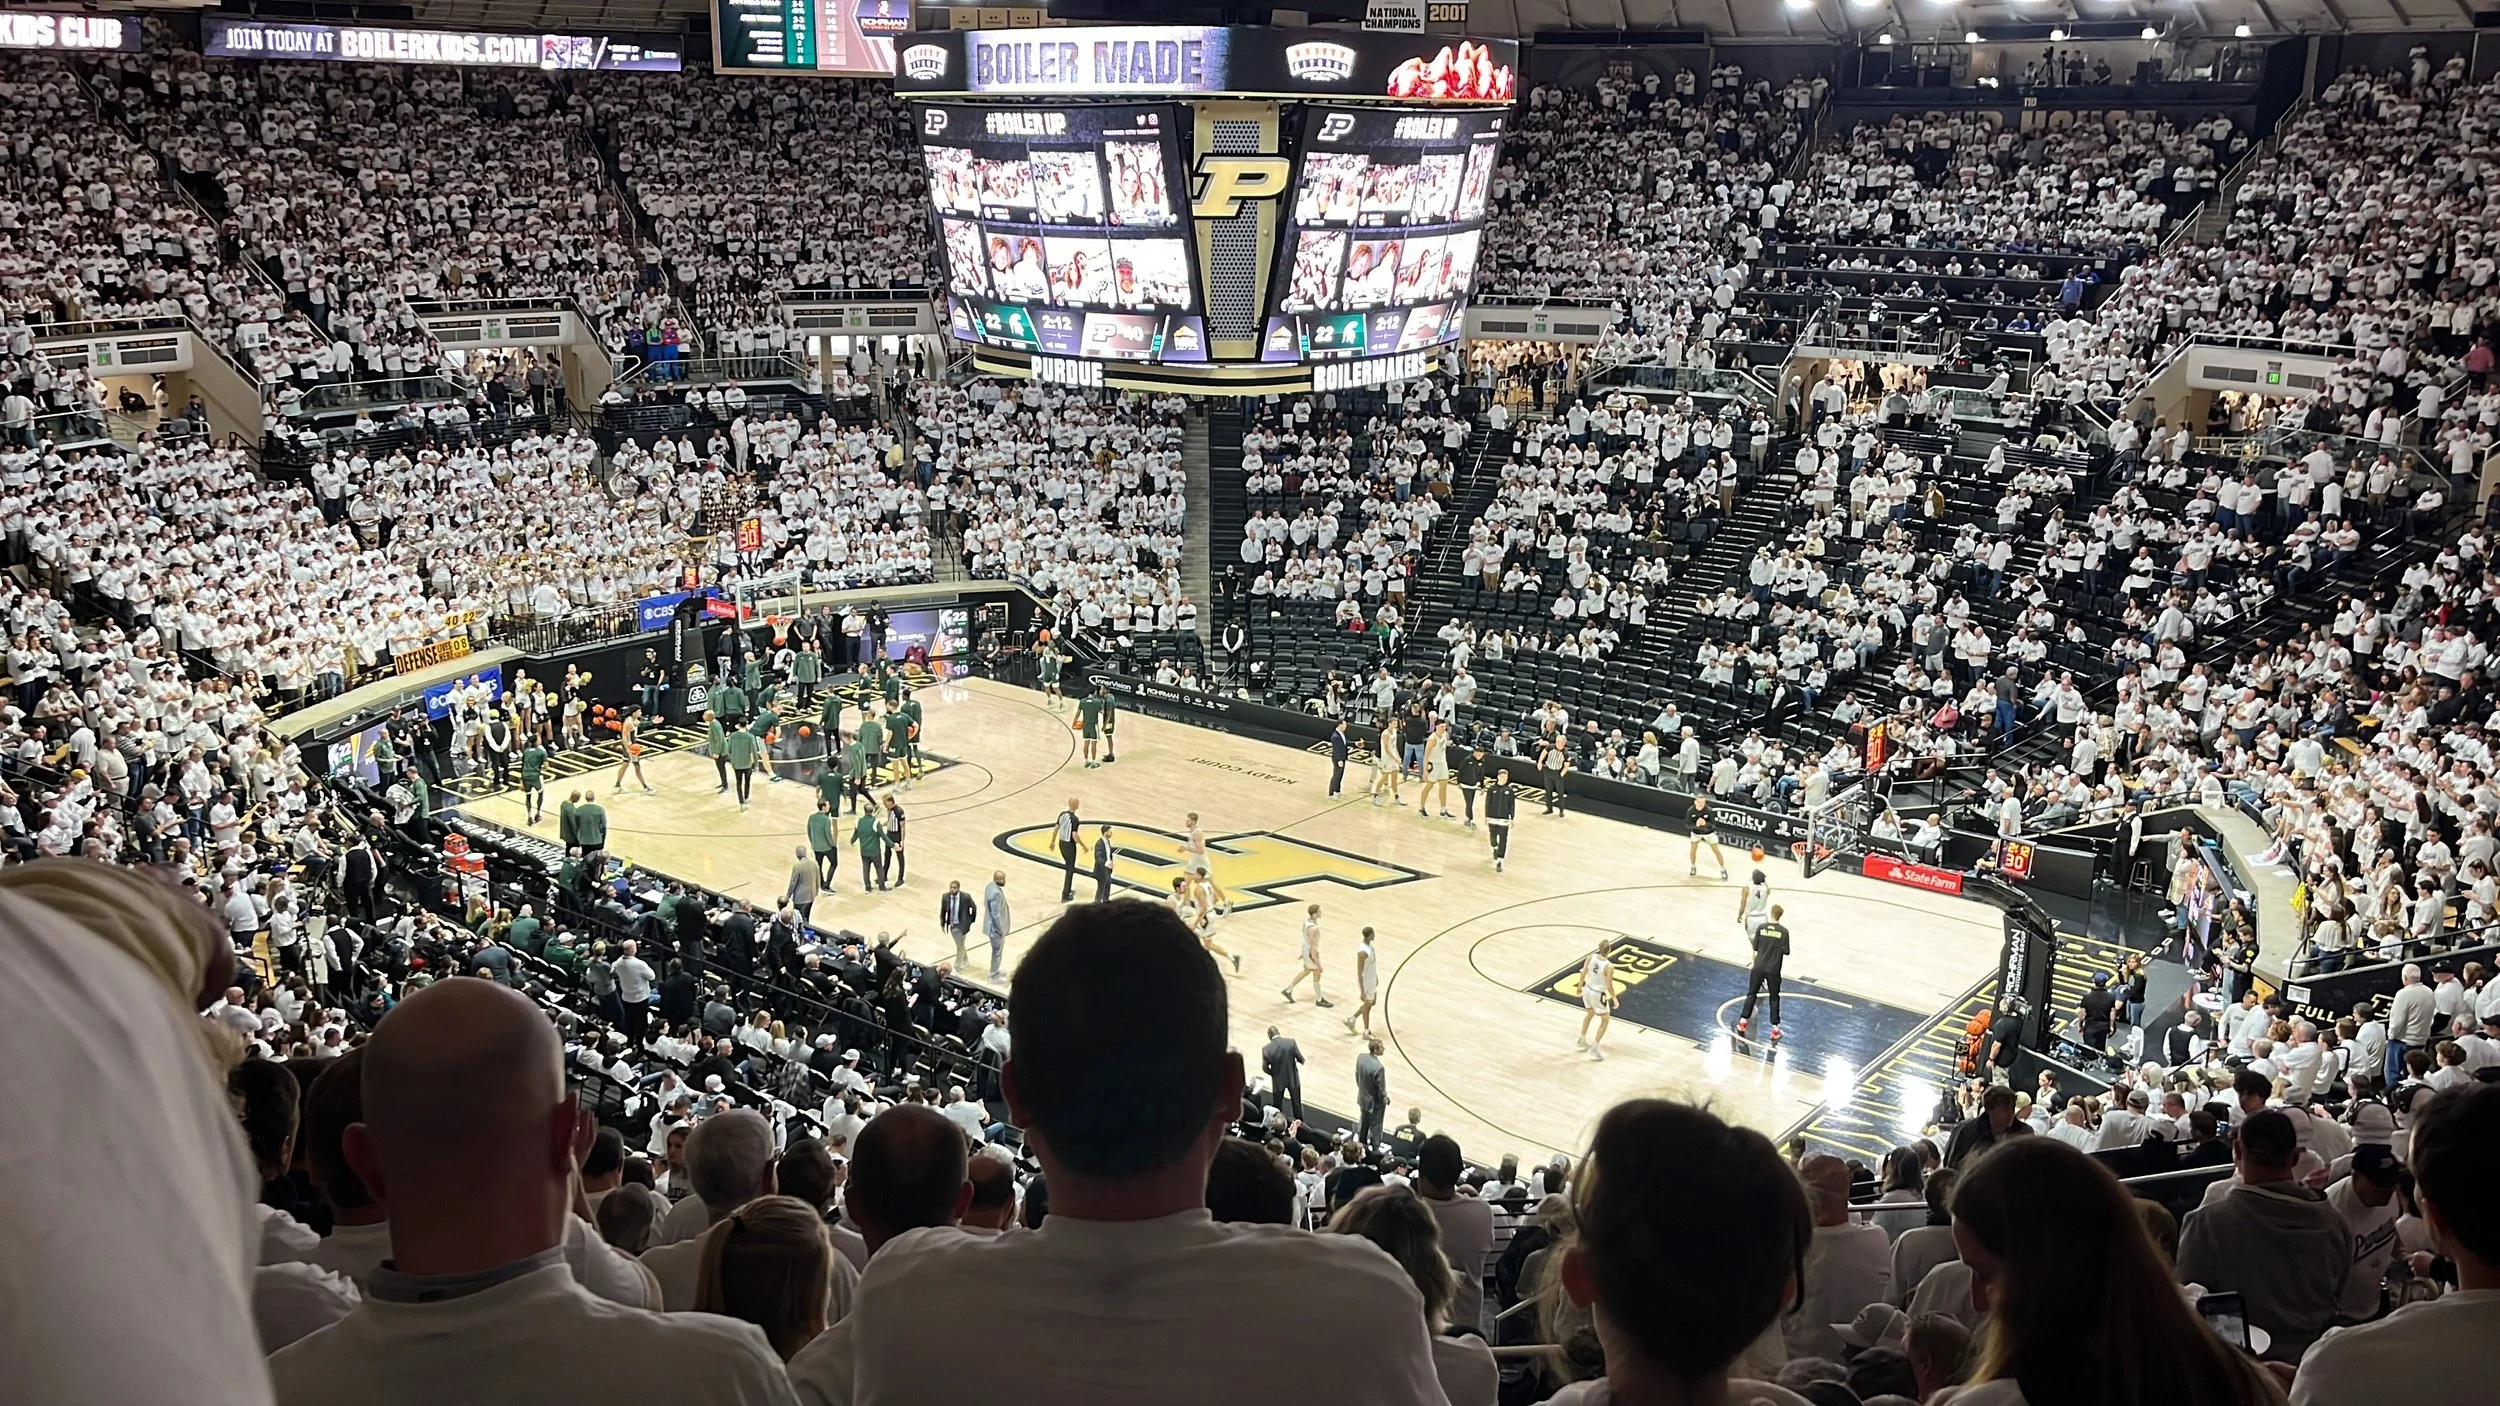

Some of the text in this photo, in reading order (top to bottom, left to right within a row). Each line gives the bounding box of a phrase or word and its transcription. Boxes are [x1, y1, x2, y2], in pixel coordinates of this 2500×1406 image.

[1369, 7, 1416, 18] NATIONAL
[1430, 5, 1466, 21] 2001
[0, 14, 122, 48] KIDS CLUB
[1365, 17, 1420, 29] CHAMPIONS
[226, 28, 537, 63] JOIN TODAY AT BOILERKIDS.COM
[977, 42, 1078, 85] BOILER
[1094, 40, 1202, 84] MADE
[986, 112, 1043, 135] #BOILER
[985, 313, 1001, 330] 22
[1315, 325, 1334, 342] 22
[1375, 316, 1400, 331] 2:12
[1031, 355, 1103, 386] PURDUE
[1314, 351, 1426, 392] BOILERMAKERS
[739, 529, 761, 549] 30
[445, 611, 475, 626] 40 22
[653, 604, 675, 618] CBS
[952, 611, 968, 622] 22
[953, 637, 969, 647] 40
[396, 645, 439, 675] DEFENSE
[1147, 688, 1180, 700] ROHRMAN
[1186, 757, 1298, 785] KEADY COURT
[1716, 811, 1767, 832] unity
[2005, 853, 2024, 870] 30
[1755, 890, 1762, 900] 4
[1593, 964, 1600, 975] 2
[2005, 928, 2021, 993] ROHRMAN
[2014, 954, 2024, 993] AUTOMOTIVE
[2294, 1003, 2336, 1023] FULL
